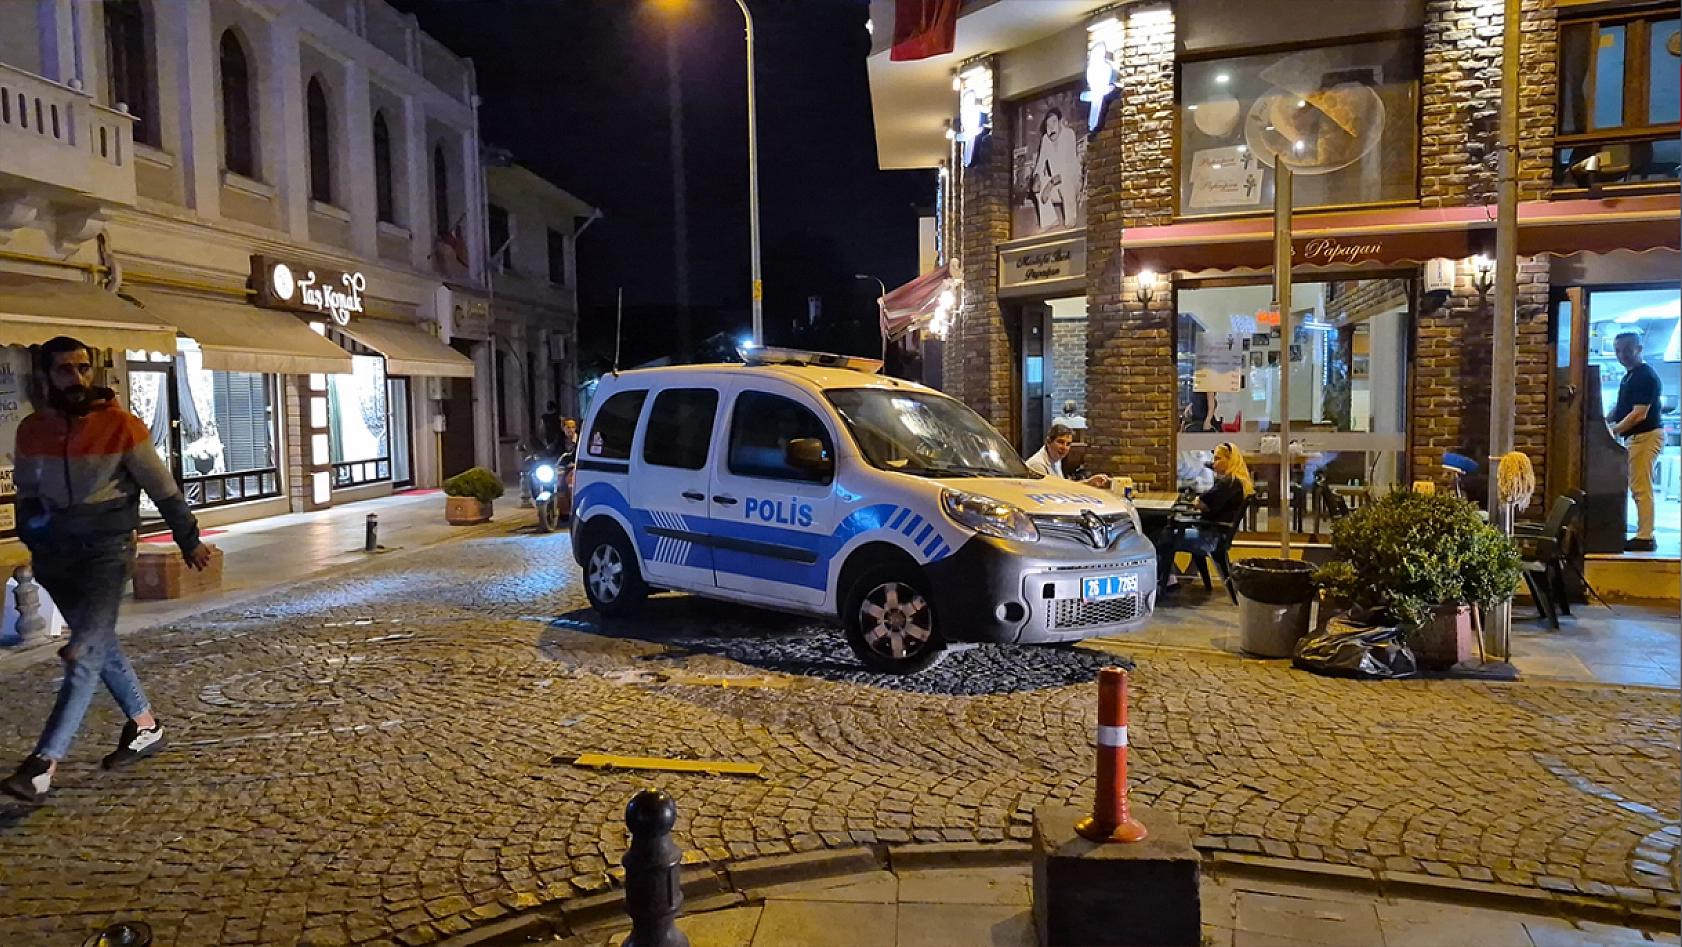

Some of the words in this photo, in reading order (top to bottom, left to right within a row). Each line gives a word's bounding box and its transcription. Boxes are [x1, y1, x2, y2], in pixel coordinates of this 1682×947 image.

[297, 270, 323, 310] Taş
[322, 271, 366, 326] Konak
[745, 496, 813, 527] POLİS
[1088, 579, 1100, 596] 26
[1106, 577, 1113, 595] A
